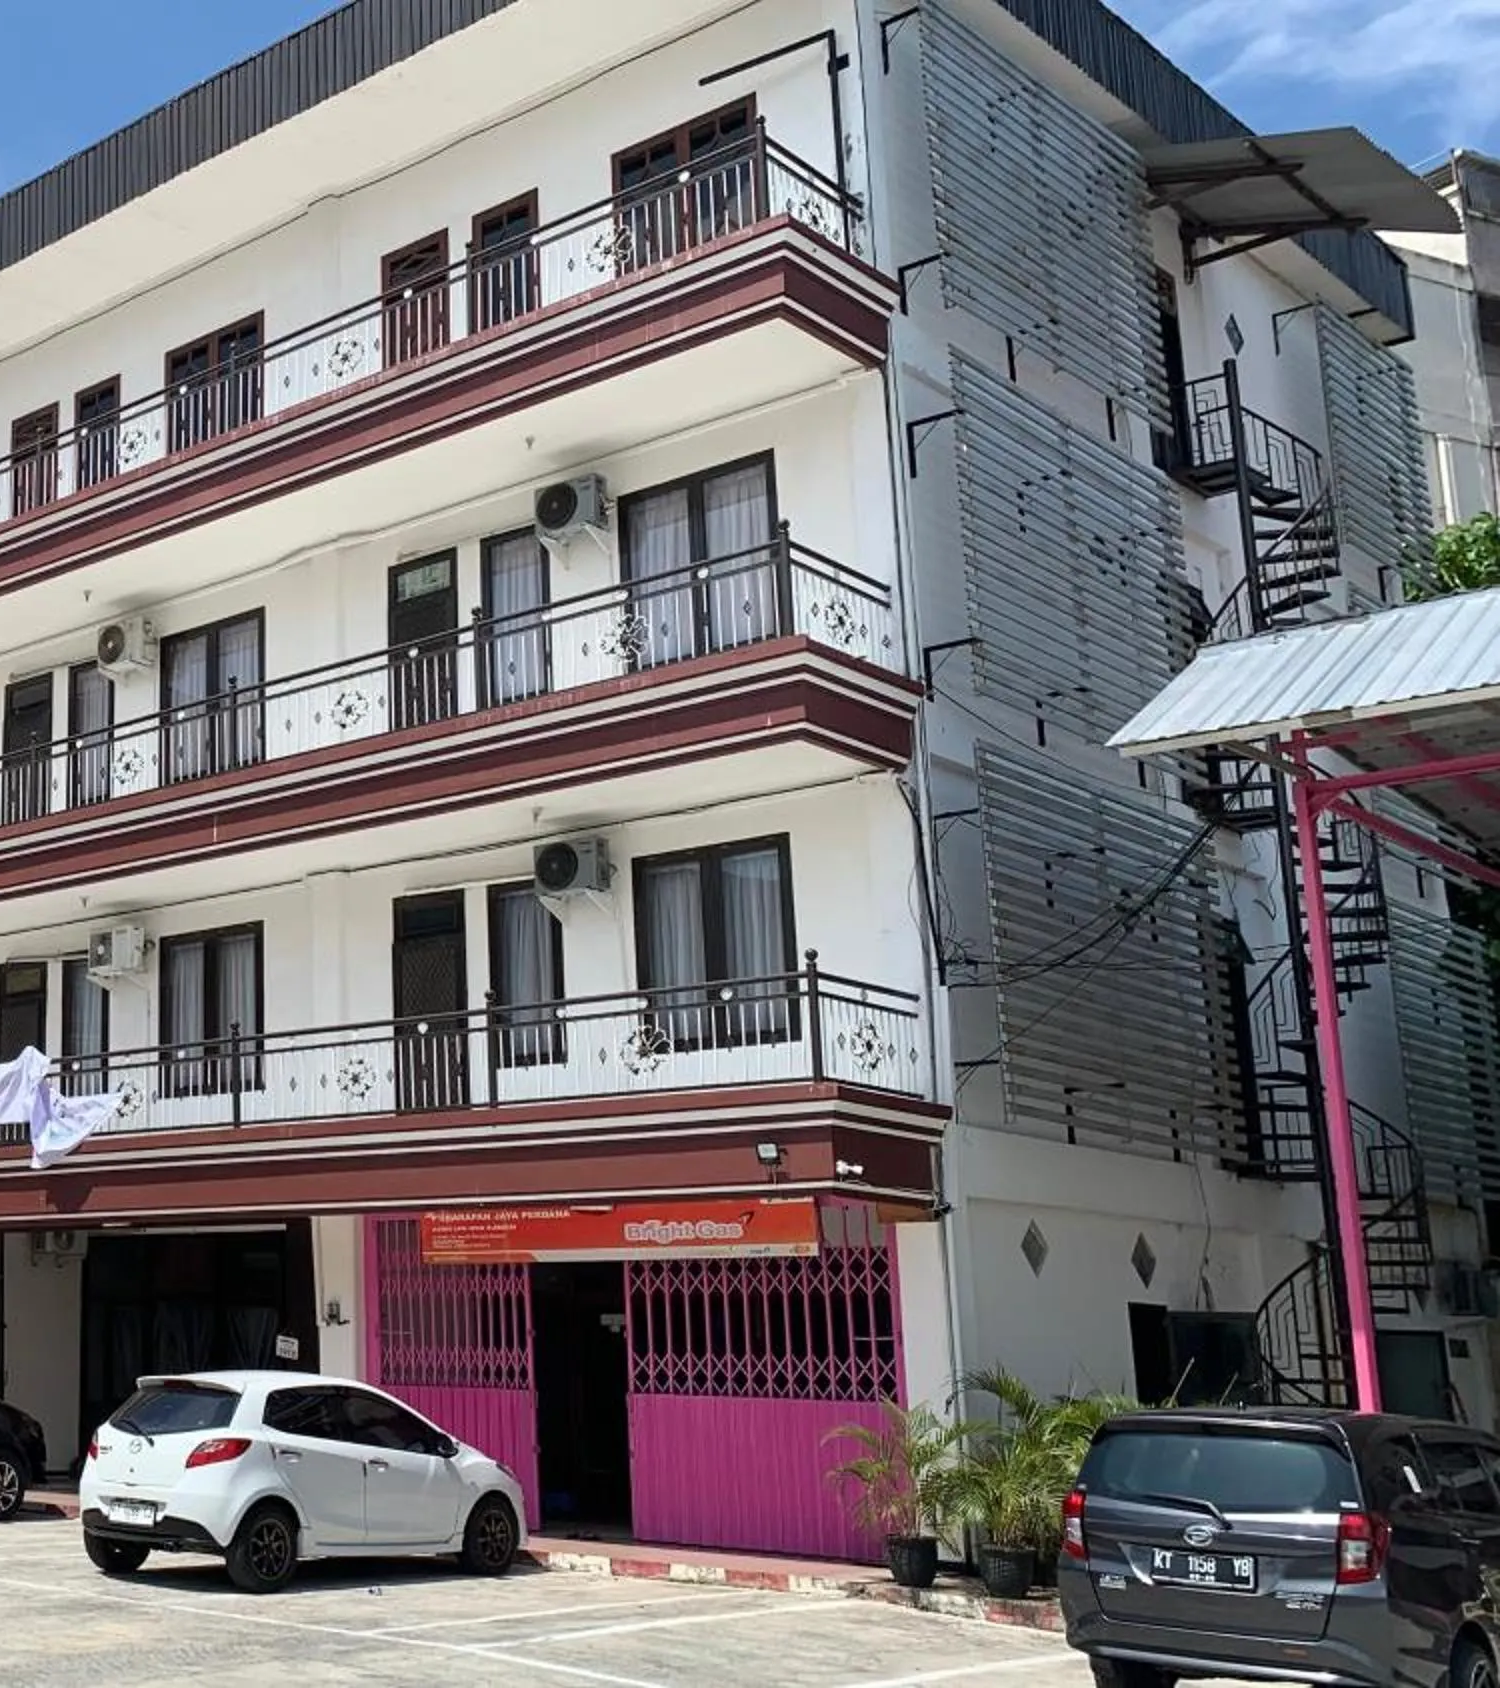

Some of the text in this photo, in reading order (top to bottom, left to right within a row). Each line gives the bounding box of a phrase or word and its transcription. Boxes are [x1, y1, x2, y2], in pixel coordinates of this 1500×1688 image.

[625, 1219, 744, 1244] Bright Gas
[1153, 1548, 1172, 1569] KT
[1188, 1556, 1216, 1574] 1158
